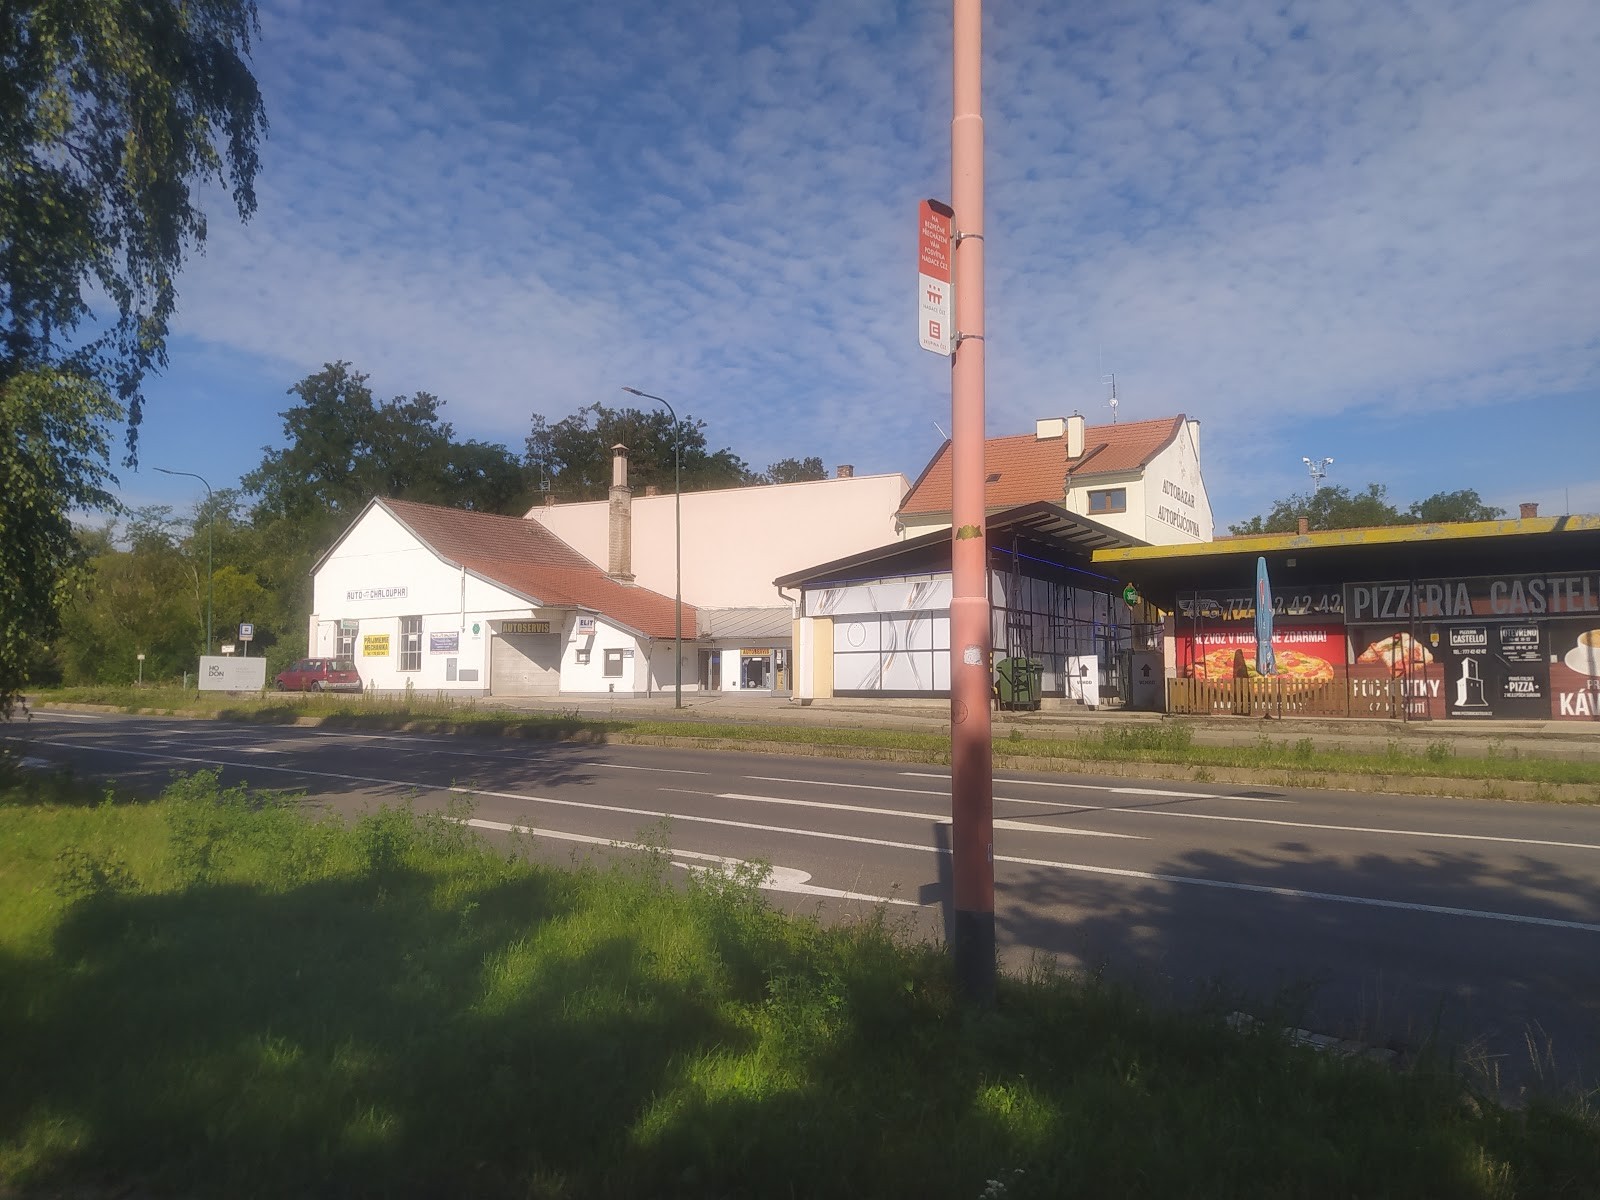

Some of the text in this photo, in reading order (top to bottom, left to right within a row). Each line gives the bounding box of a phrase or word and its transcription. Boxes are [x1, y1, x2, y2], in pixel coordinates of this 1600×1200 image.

[1162, 479, 1195, 508] AUTOBAZAR
[347, 591, 363, 600] AUTO
[1354, 576, 1600, 618] PIZZERIA CASTEL
[502, 623, 549, 633] AUTOSERVIS
[1228, 632, 1235, 644] V
[1283, 630, 1327, 643] ZDARMA!
[1453, 634, 1484, 643] CASTELLO
[1509, 682, 1534, 692] PIZZA
